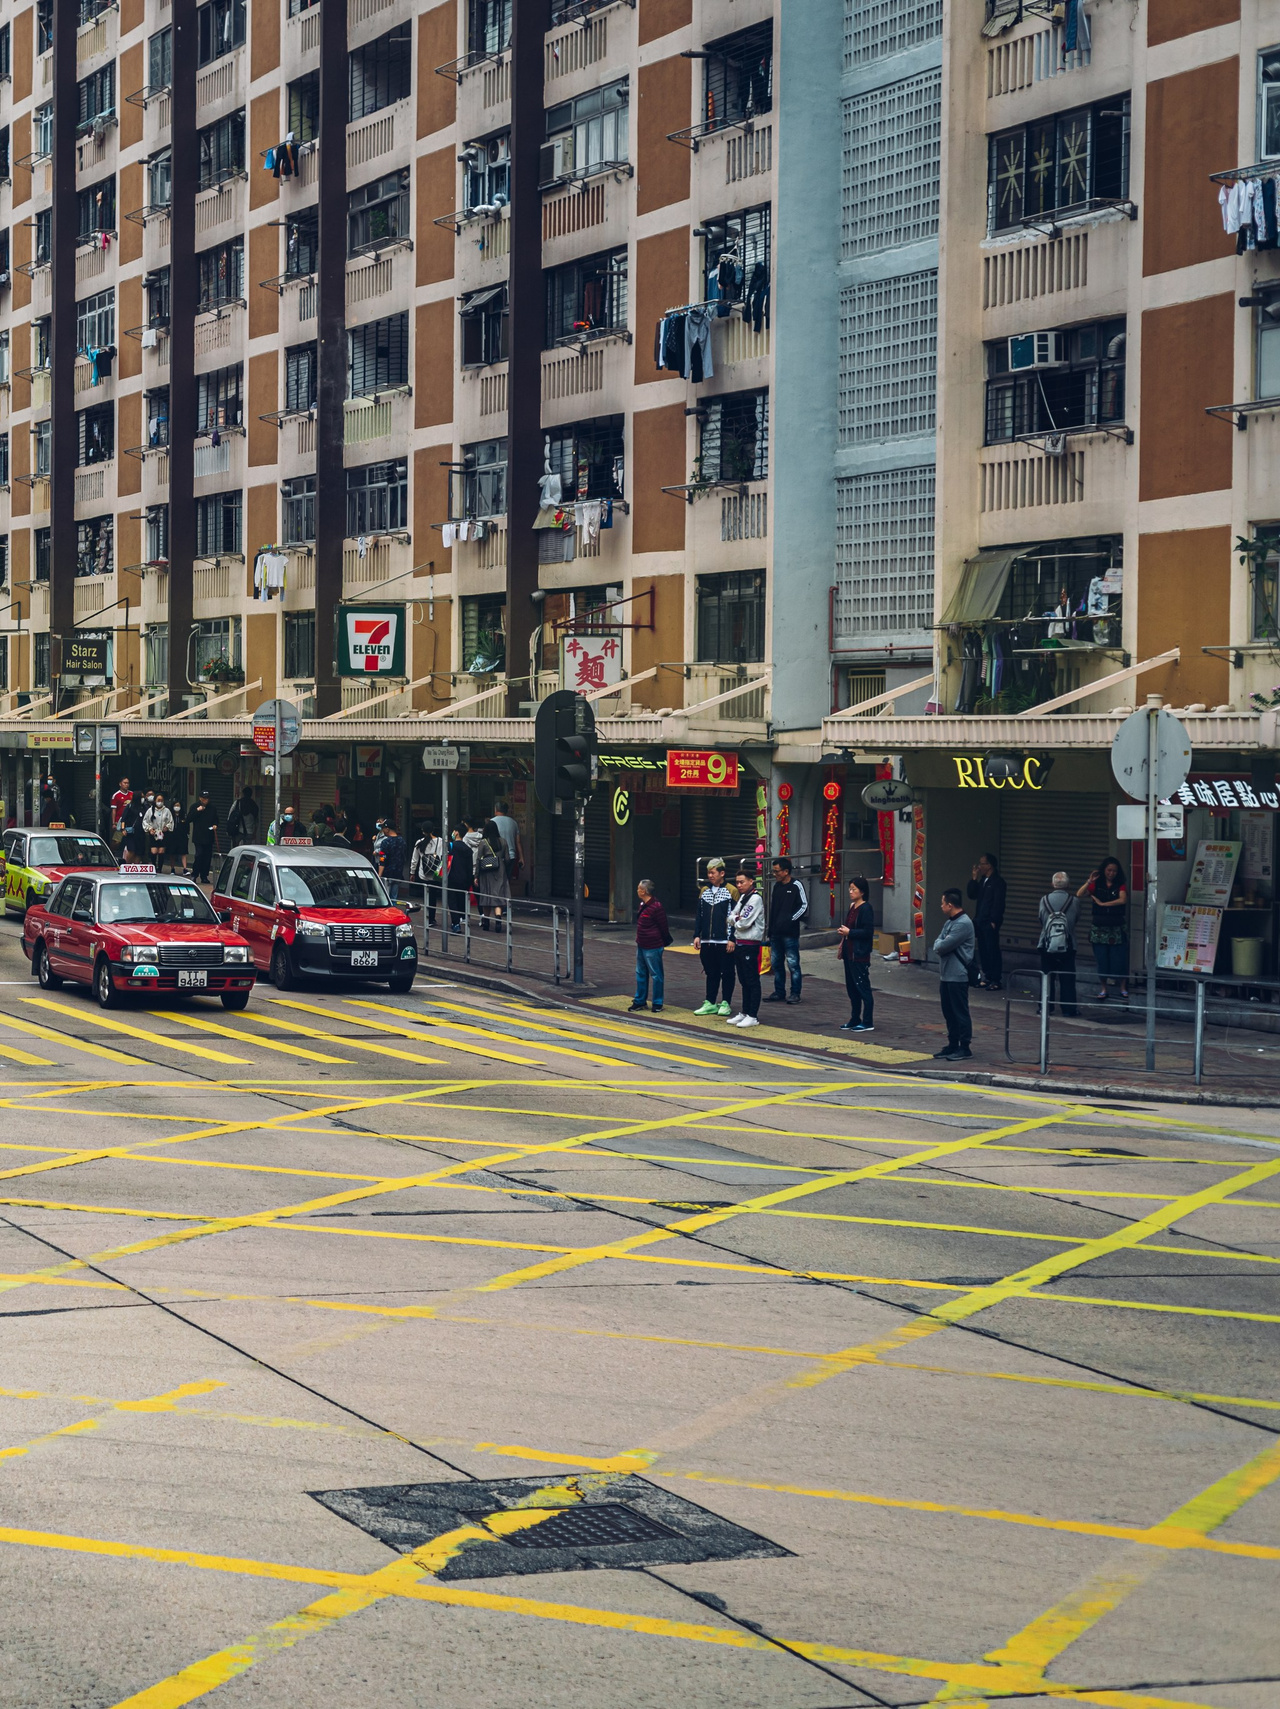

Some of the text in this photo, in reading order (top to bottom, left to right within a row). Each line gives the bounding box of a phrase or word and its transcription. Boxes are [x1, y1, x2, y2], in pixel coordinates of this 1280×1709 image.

[71, 643, 98, 657] Starz
[355, 620, 390, 671] 7
[66, 659, 103, 669] Hair Salon
[598, 755, 657, 769] FREE
[707, 754, 727, 784] 9
[283, 837, 312, 845] TAXI
[123, 865, 154, 873] TAXI
[359, 951, 371, 959] JN
[353, 958, 377, 966] 8662
[186, 971, 199, 979] TT
[180, 978, 205, 987] 9428
